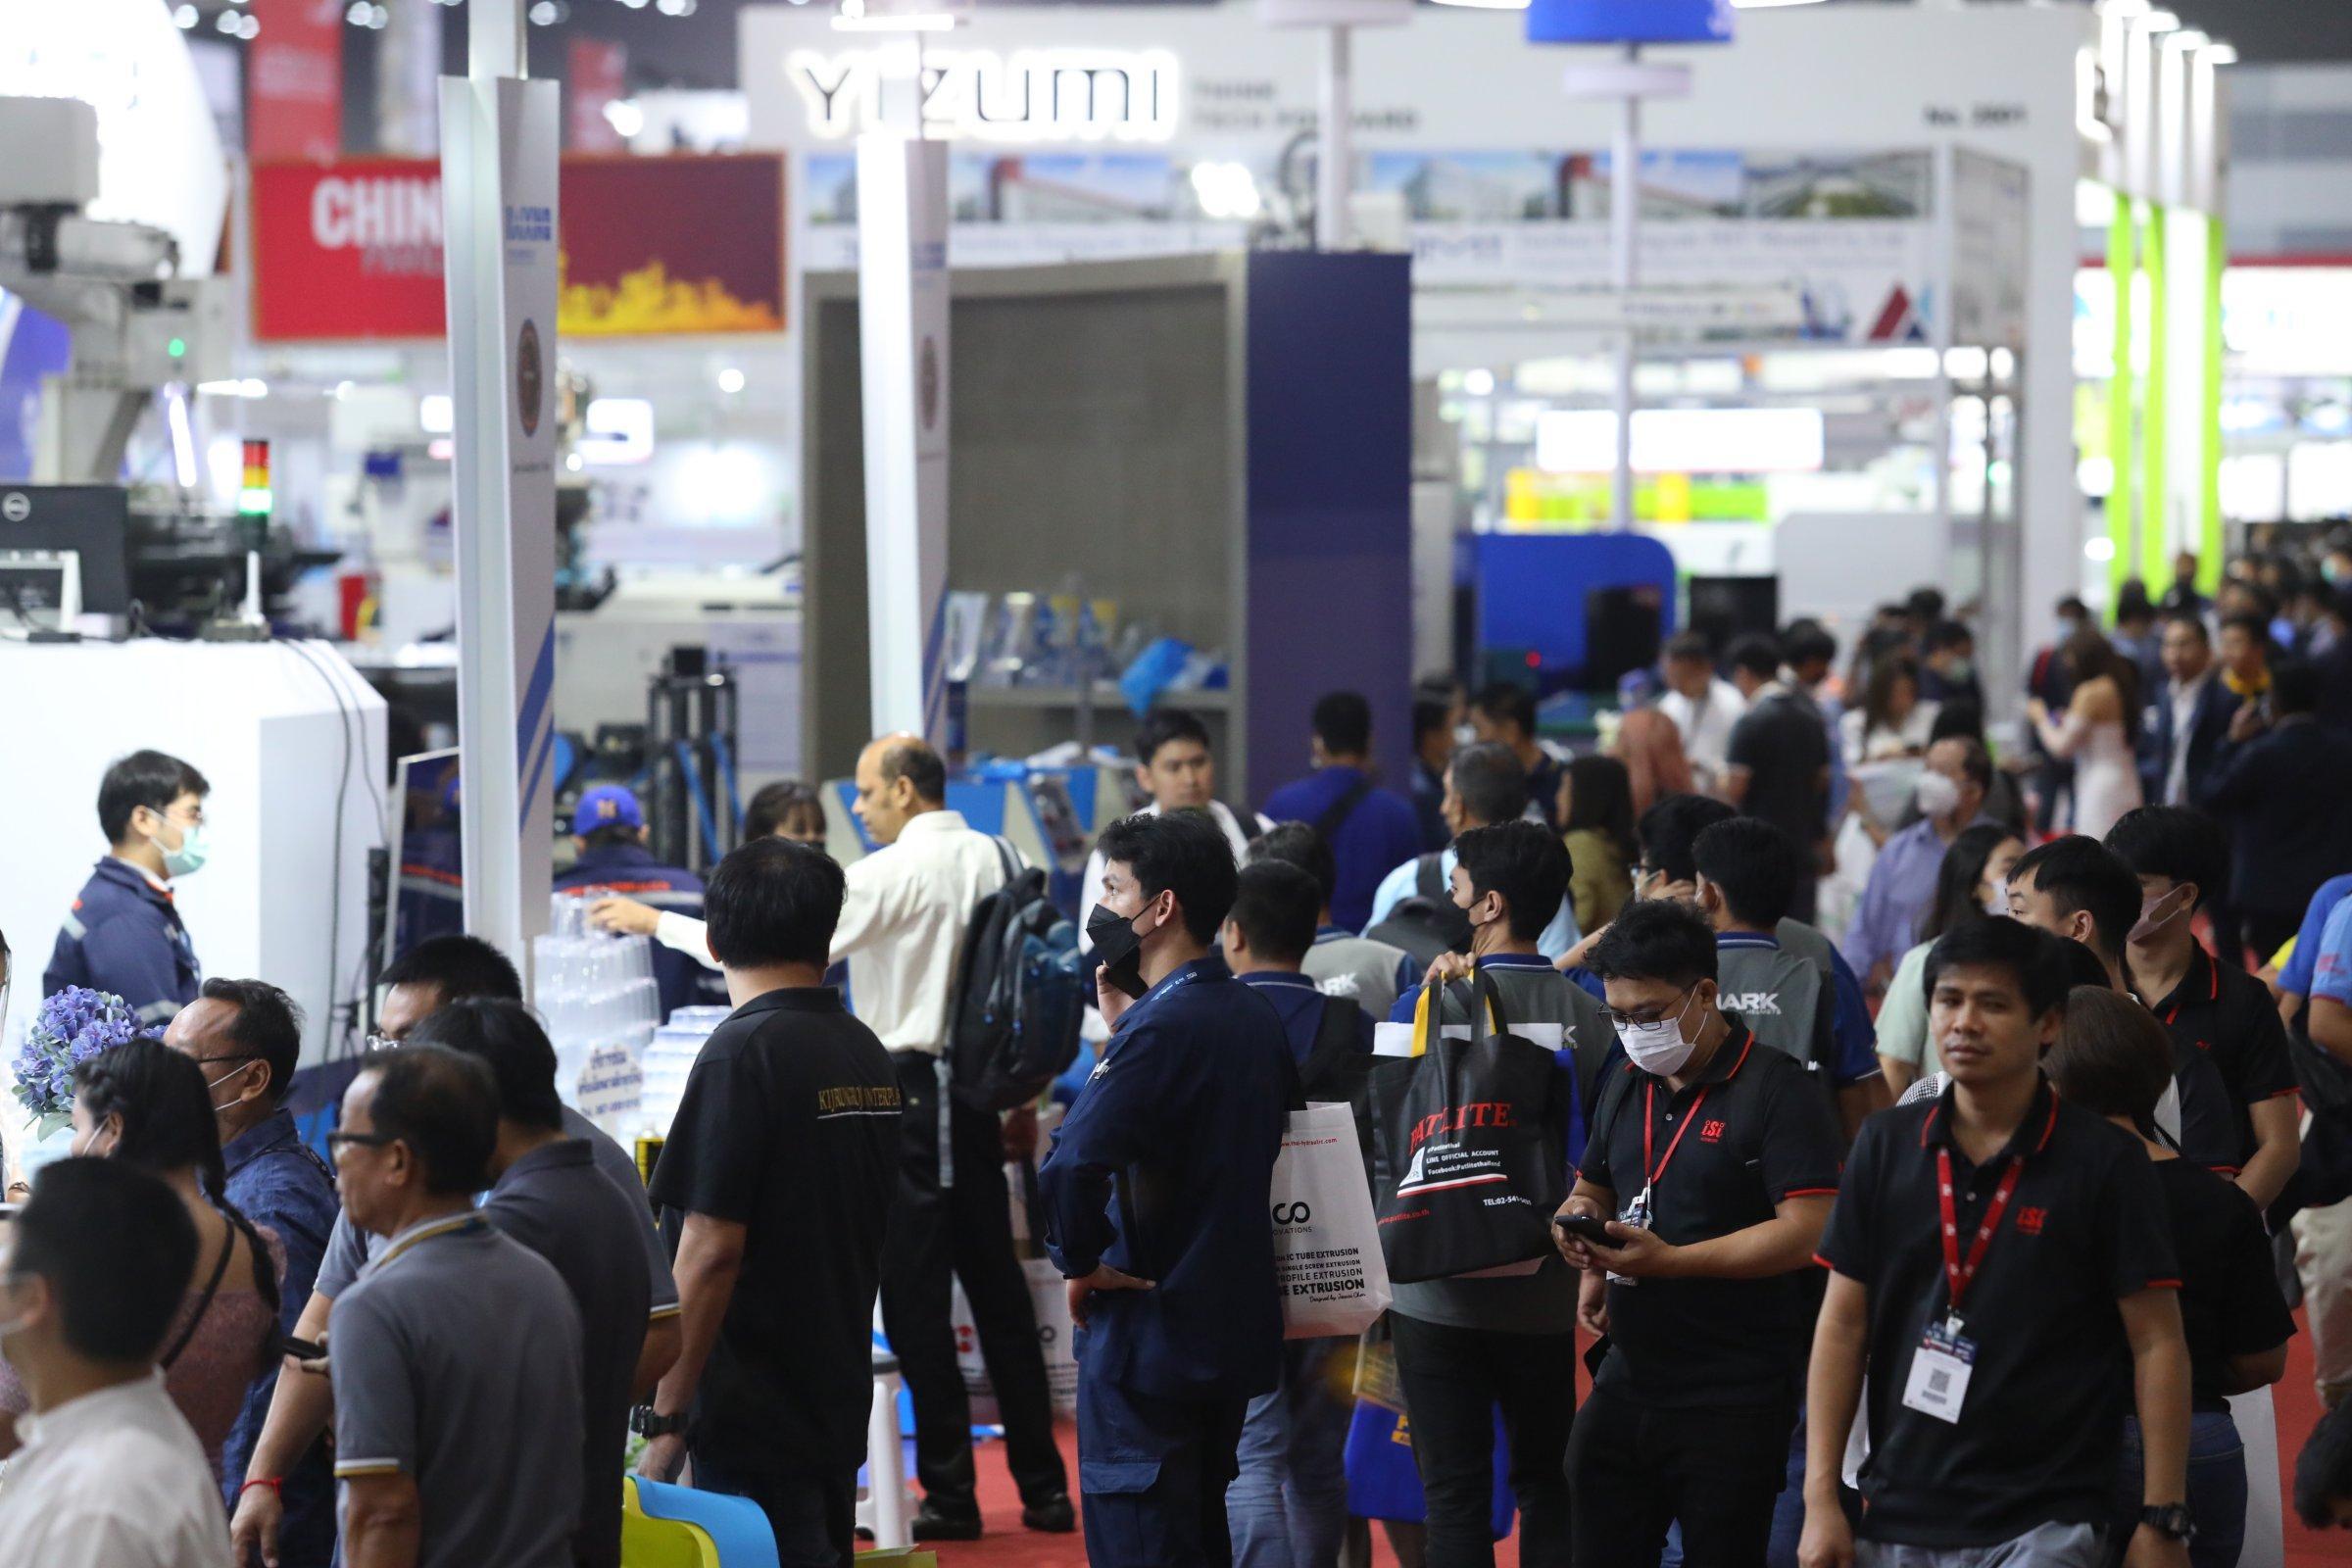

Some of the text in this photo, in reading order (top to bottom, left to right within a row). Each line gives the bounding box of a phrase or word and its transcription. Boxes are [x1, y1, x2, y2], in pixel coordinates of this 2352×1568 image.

[1408, 1102, 1513, 1156] PATLITE
[1426, 1149, 1499, 1164] LINE OFFICIAL ACCOUNT
[1316, 1248, 1359, 1258] EXTRUSION
[1326, 1259, 1361, 1269] EXTRUSION
[1313, 1268, 1363, 1281] EXTRUSION
[1293, 1279, 1365, 1296] EXTRUSION
